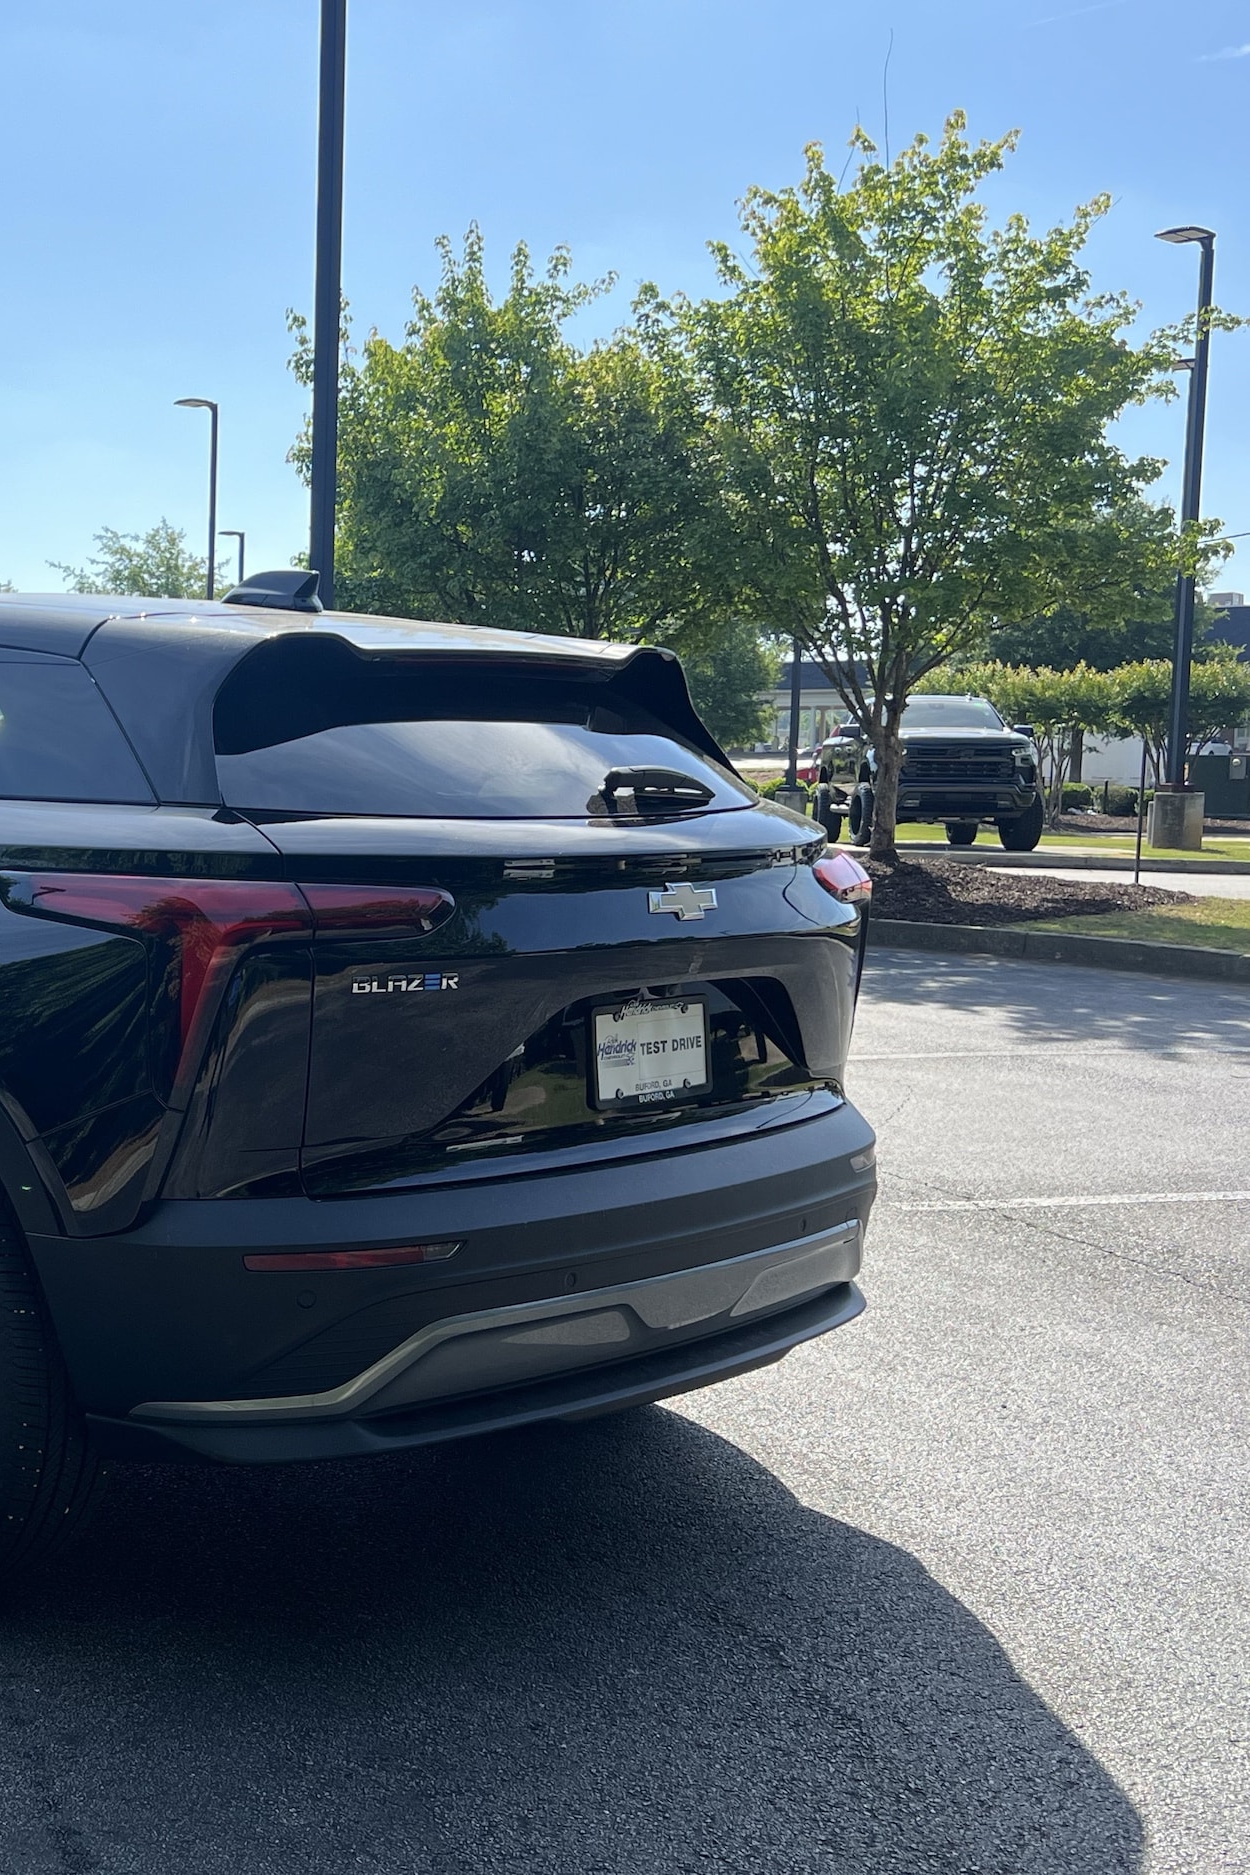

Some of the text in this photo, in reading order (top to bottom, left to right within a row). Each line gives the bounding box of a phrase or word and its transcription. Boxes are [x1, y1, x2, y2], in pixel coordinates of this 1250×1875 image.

[352, 972, 459, 994] BLAZER
[597, 1039, 637, 1060] Hendrick
[640, 1035, 702, 1056] TEST DRIVE
[663, 1079, 672, 1088] GA
[665, 1090, 675, 1099] GA
